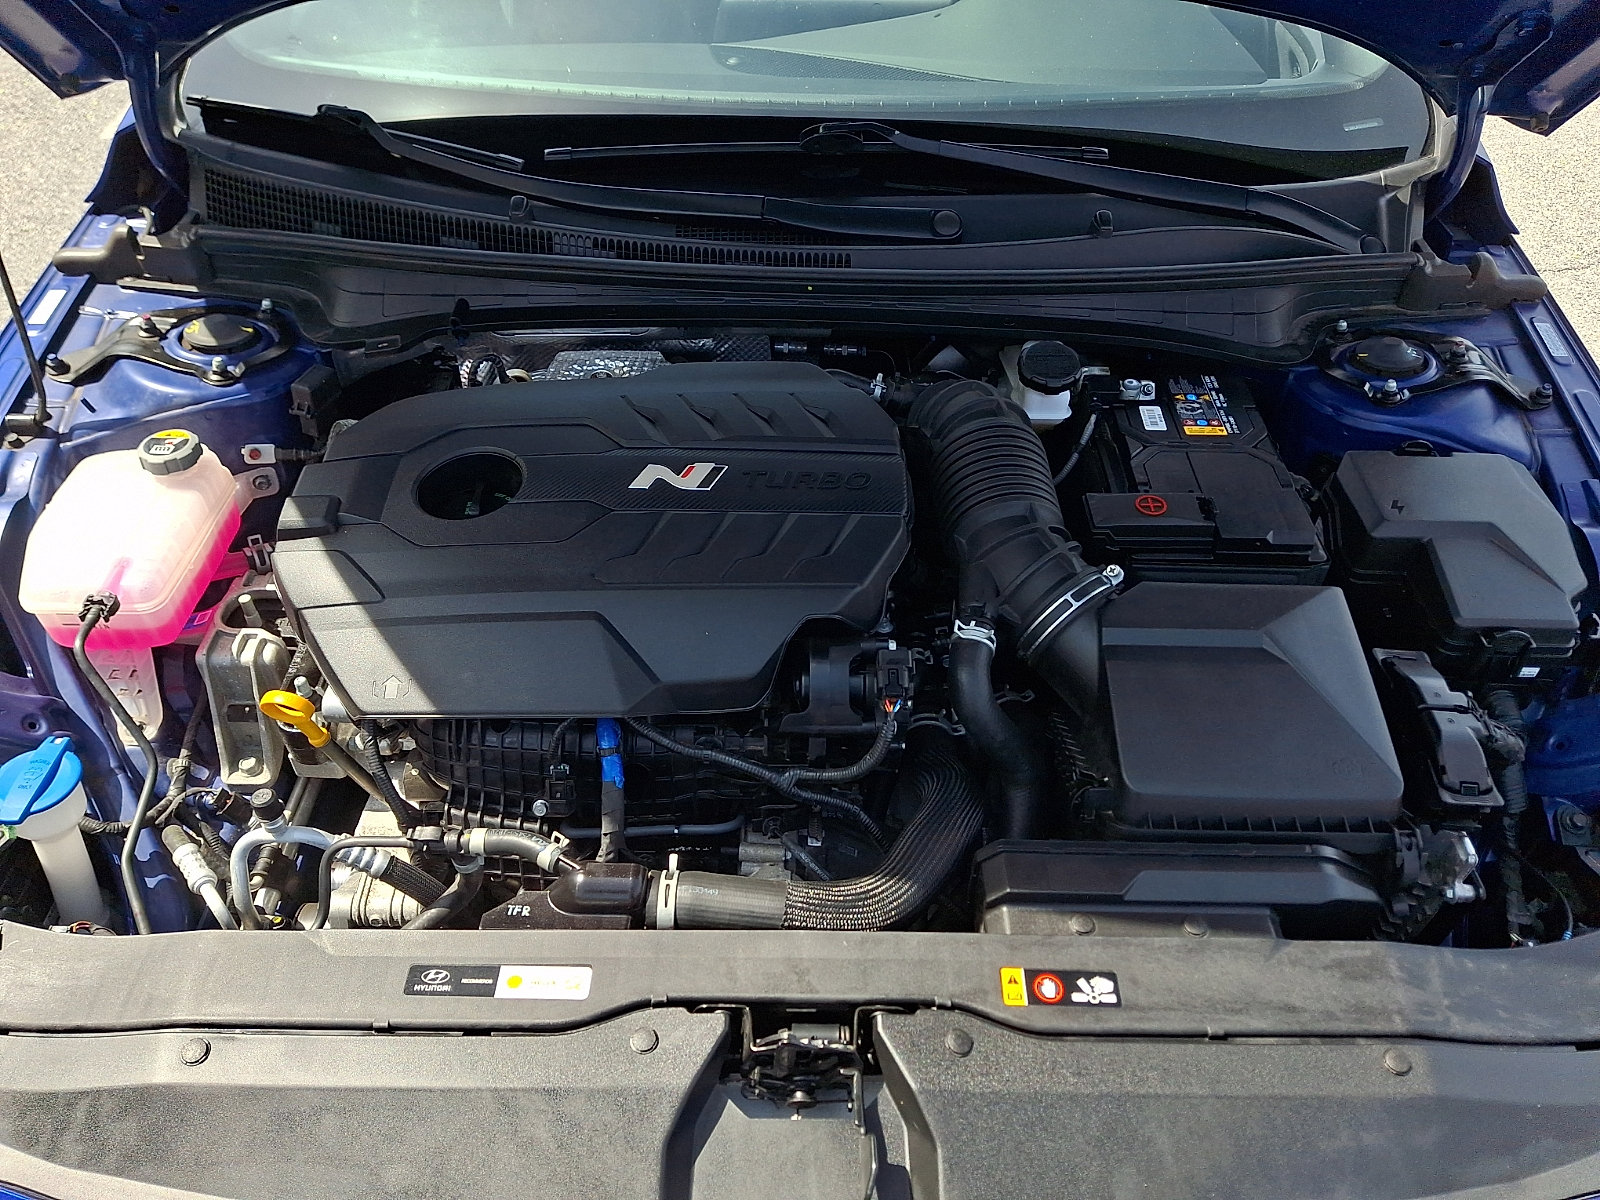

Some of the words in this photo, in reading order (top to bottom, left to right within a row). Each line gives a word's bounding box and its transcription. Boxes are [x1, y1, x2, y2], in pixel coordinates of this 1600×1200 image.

[742, 470, 873, 491] TURBO
[507, 904, 531, 917] TFR
[413, 984, 452, 992] HYUNDAI
